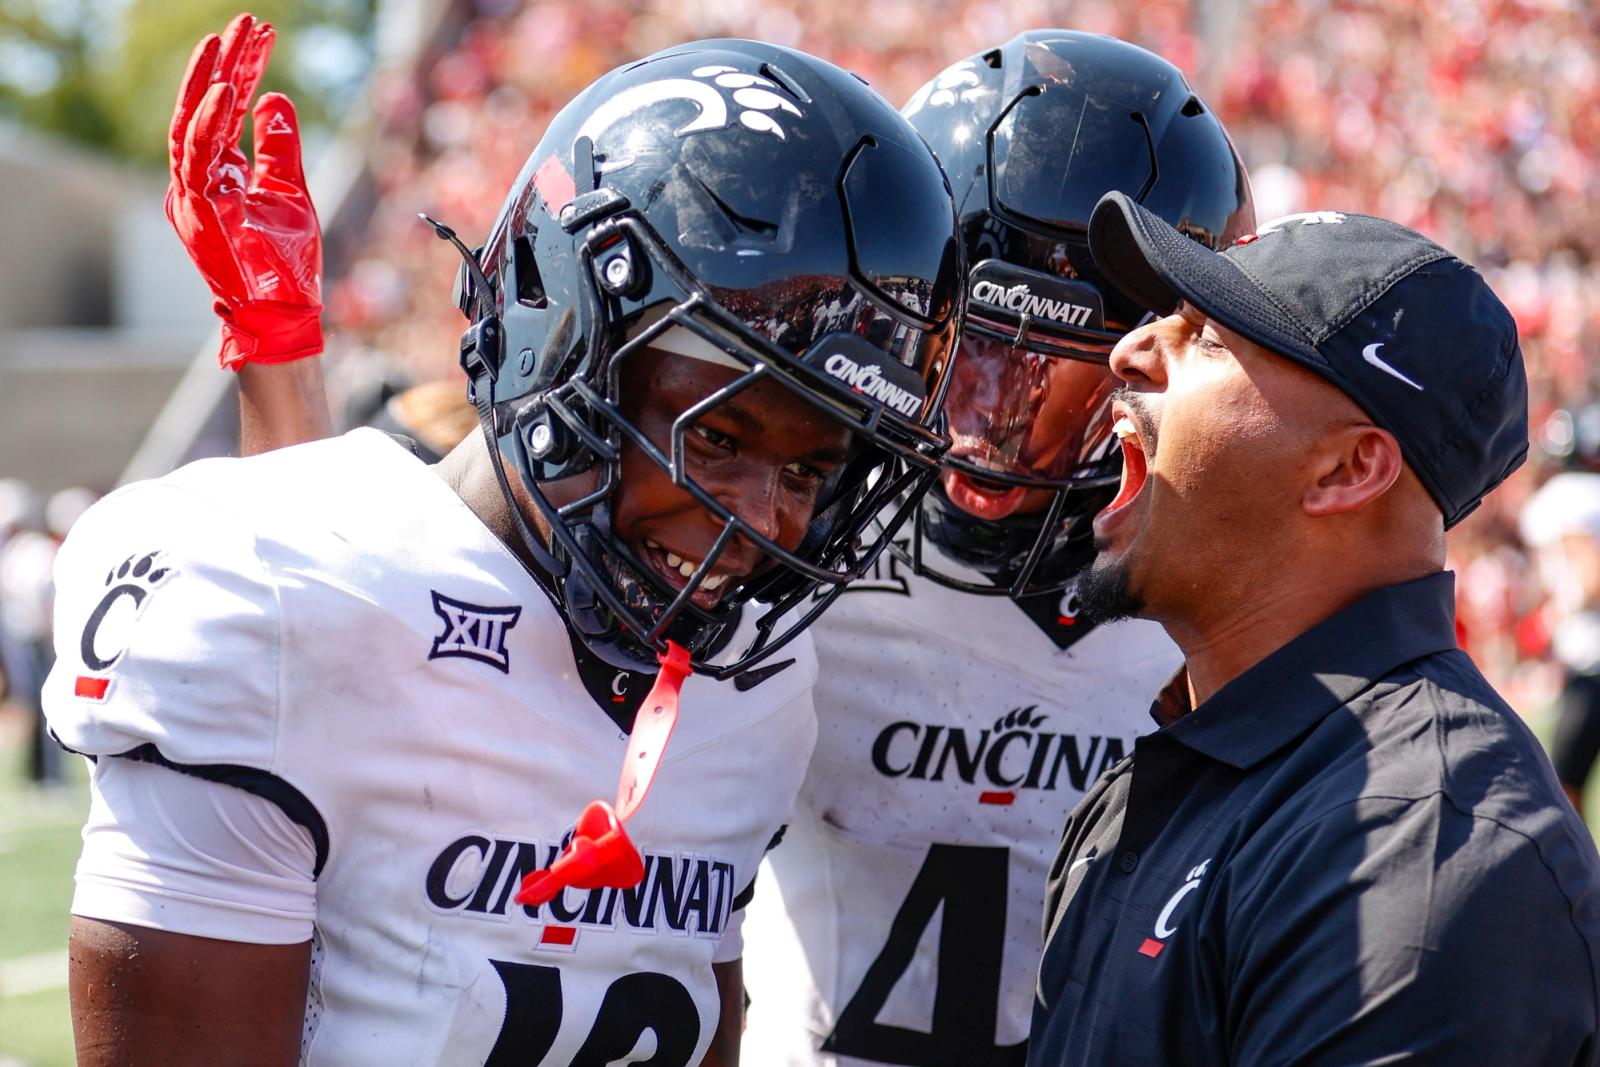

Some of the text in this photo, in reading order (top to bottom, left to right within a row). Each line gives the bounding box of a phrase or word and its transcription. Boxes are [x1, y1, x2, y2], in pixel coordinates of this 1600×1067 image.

[971, 280, 1094, 327] CINCINNATI
[824, 353, 923, 418] CINCINNATI
[611, 670, 630, 696] C
[820, 843, 1029, 1067] 4
